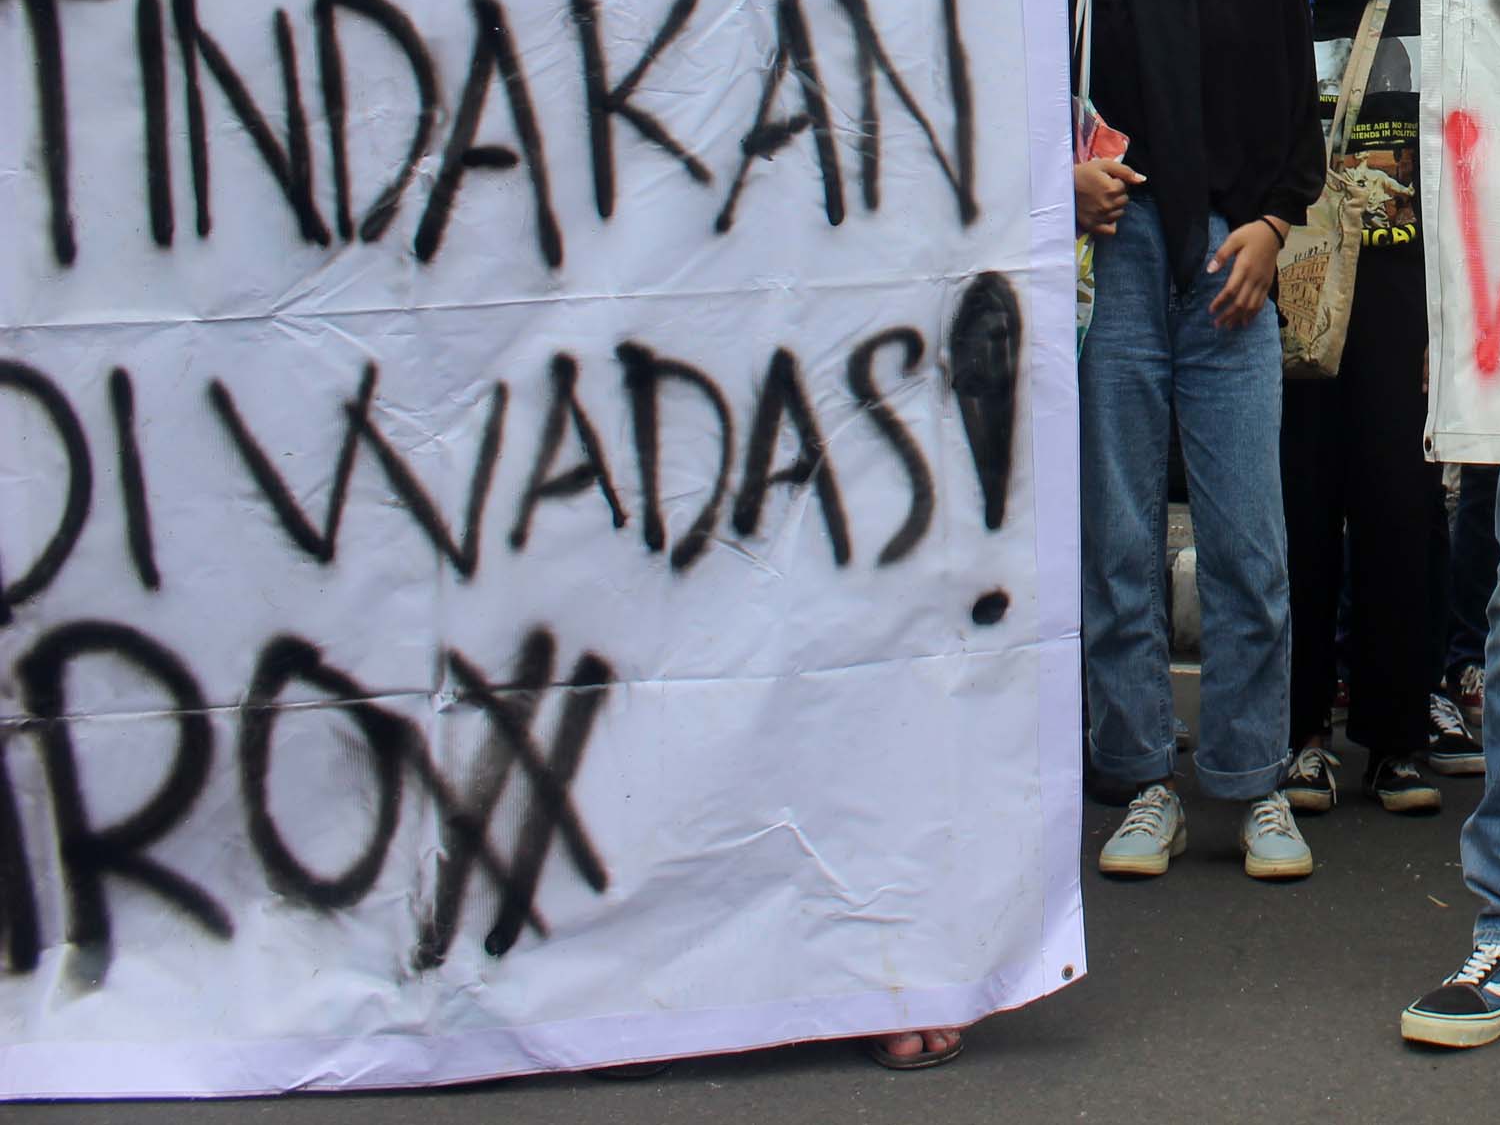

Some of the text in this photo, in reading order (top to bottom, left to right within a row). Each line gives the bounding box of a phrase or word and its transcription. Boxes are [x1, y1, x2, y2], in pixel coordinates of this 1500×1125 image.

[1351, 131, 1380, 139] RIENDS
[1393, 129, 1417, 137] POLITIC
[1361, 224, 1416, 246] ICA
[210, 270, 1024, 626] WADAS!
